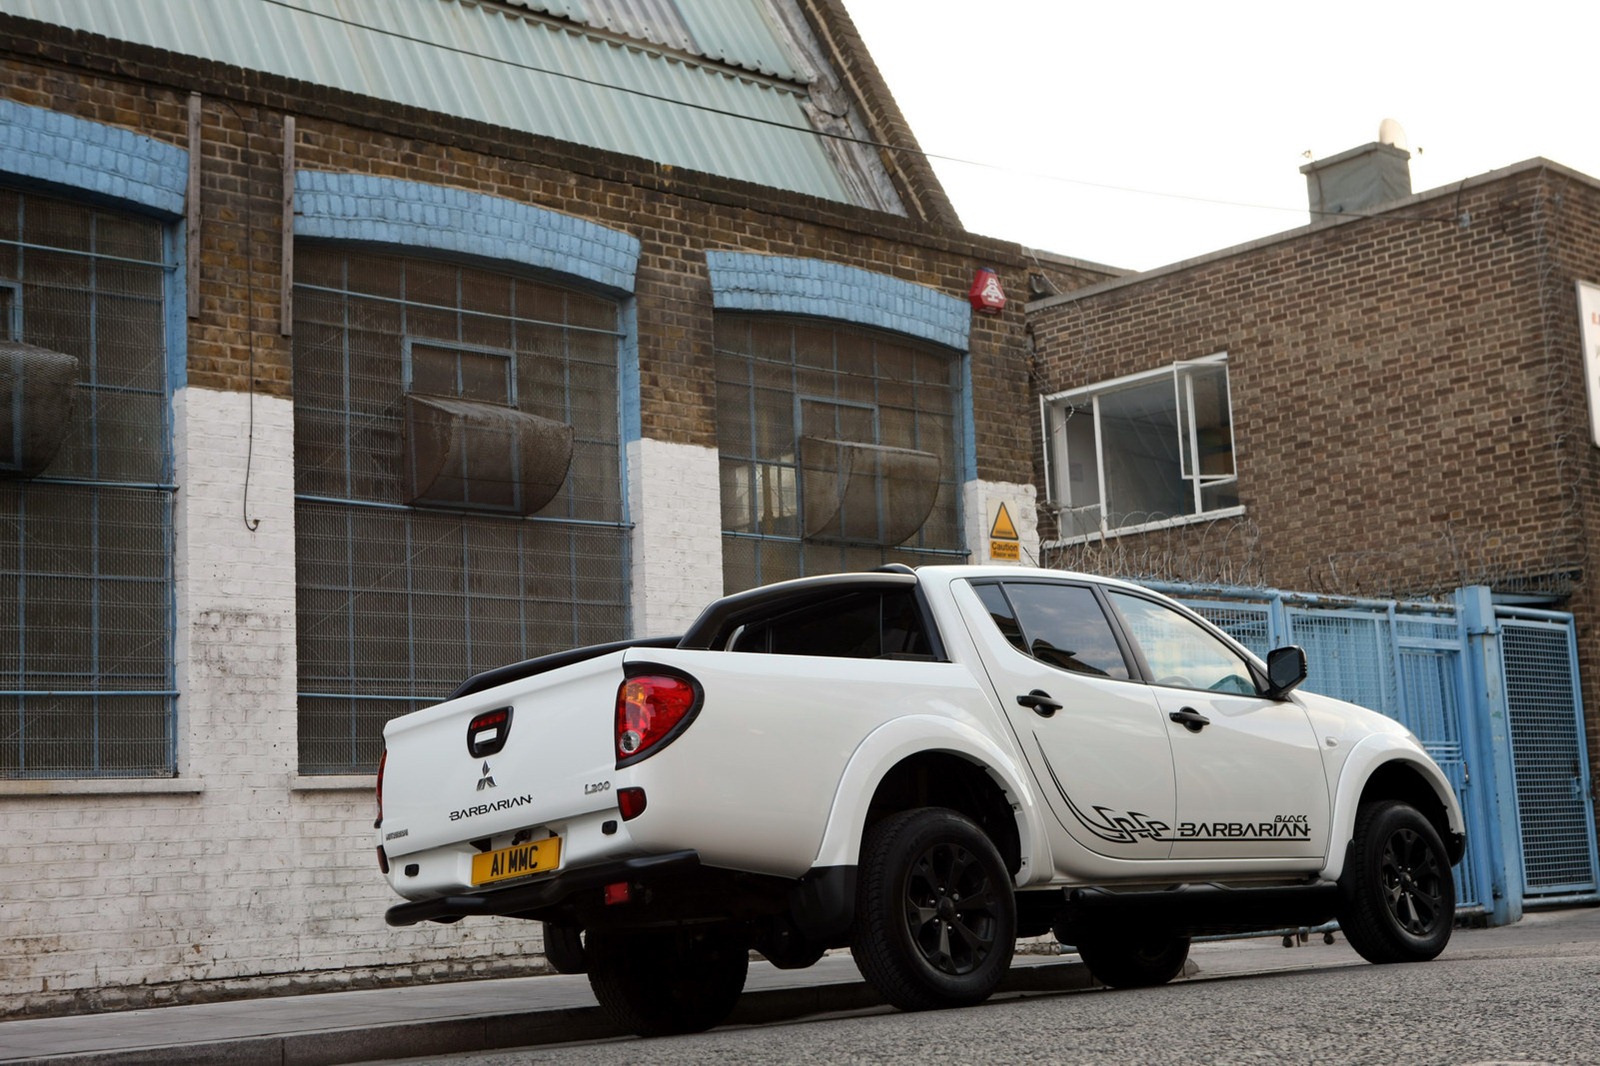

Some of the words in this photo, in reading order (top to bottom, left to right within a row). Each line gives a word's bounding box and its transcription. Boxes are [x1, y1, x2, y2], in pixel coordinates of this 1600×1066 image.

[991, 541, 1018, 551] Caution
[584, 780, 611, 795] L200
[449, 794, 533, 821] BARBARIAN
[1274, 814, 1307, 823] BLACK
[1177, 822, 1311, 837] BARBARIAN
[508, 845, 539, 873] MMC
